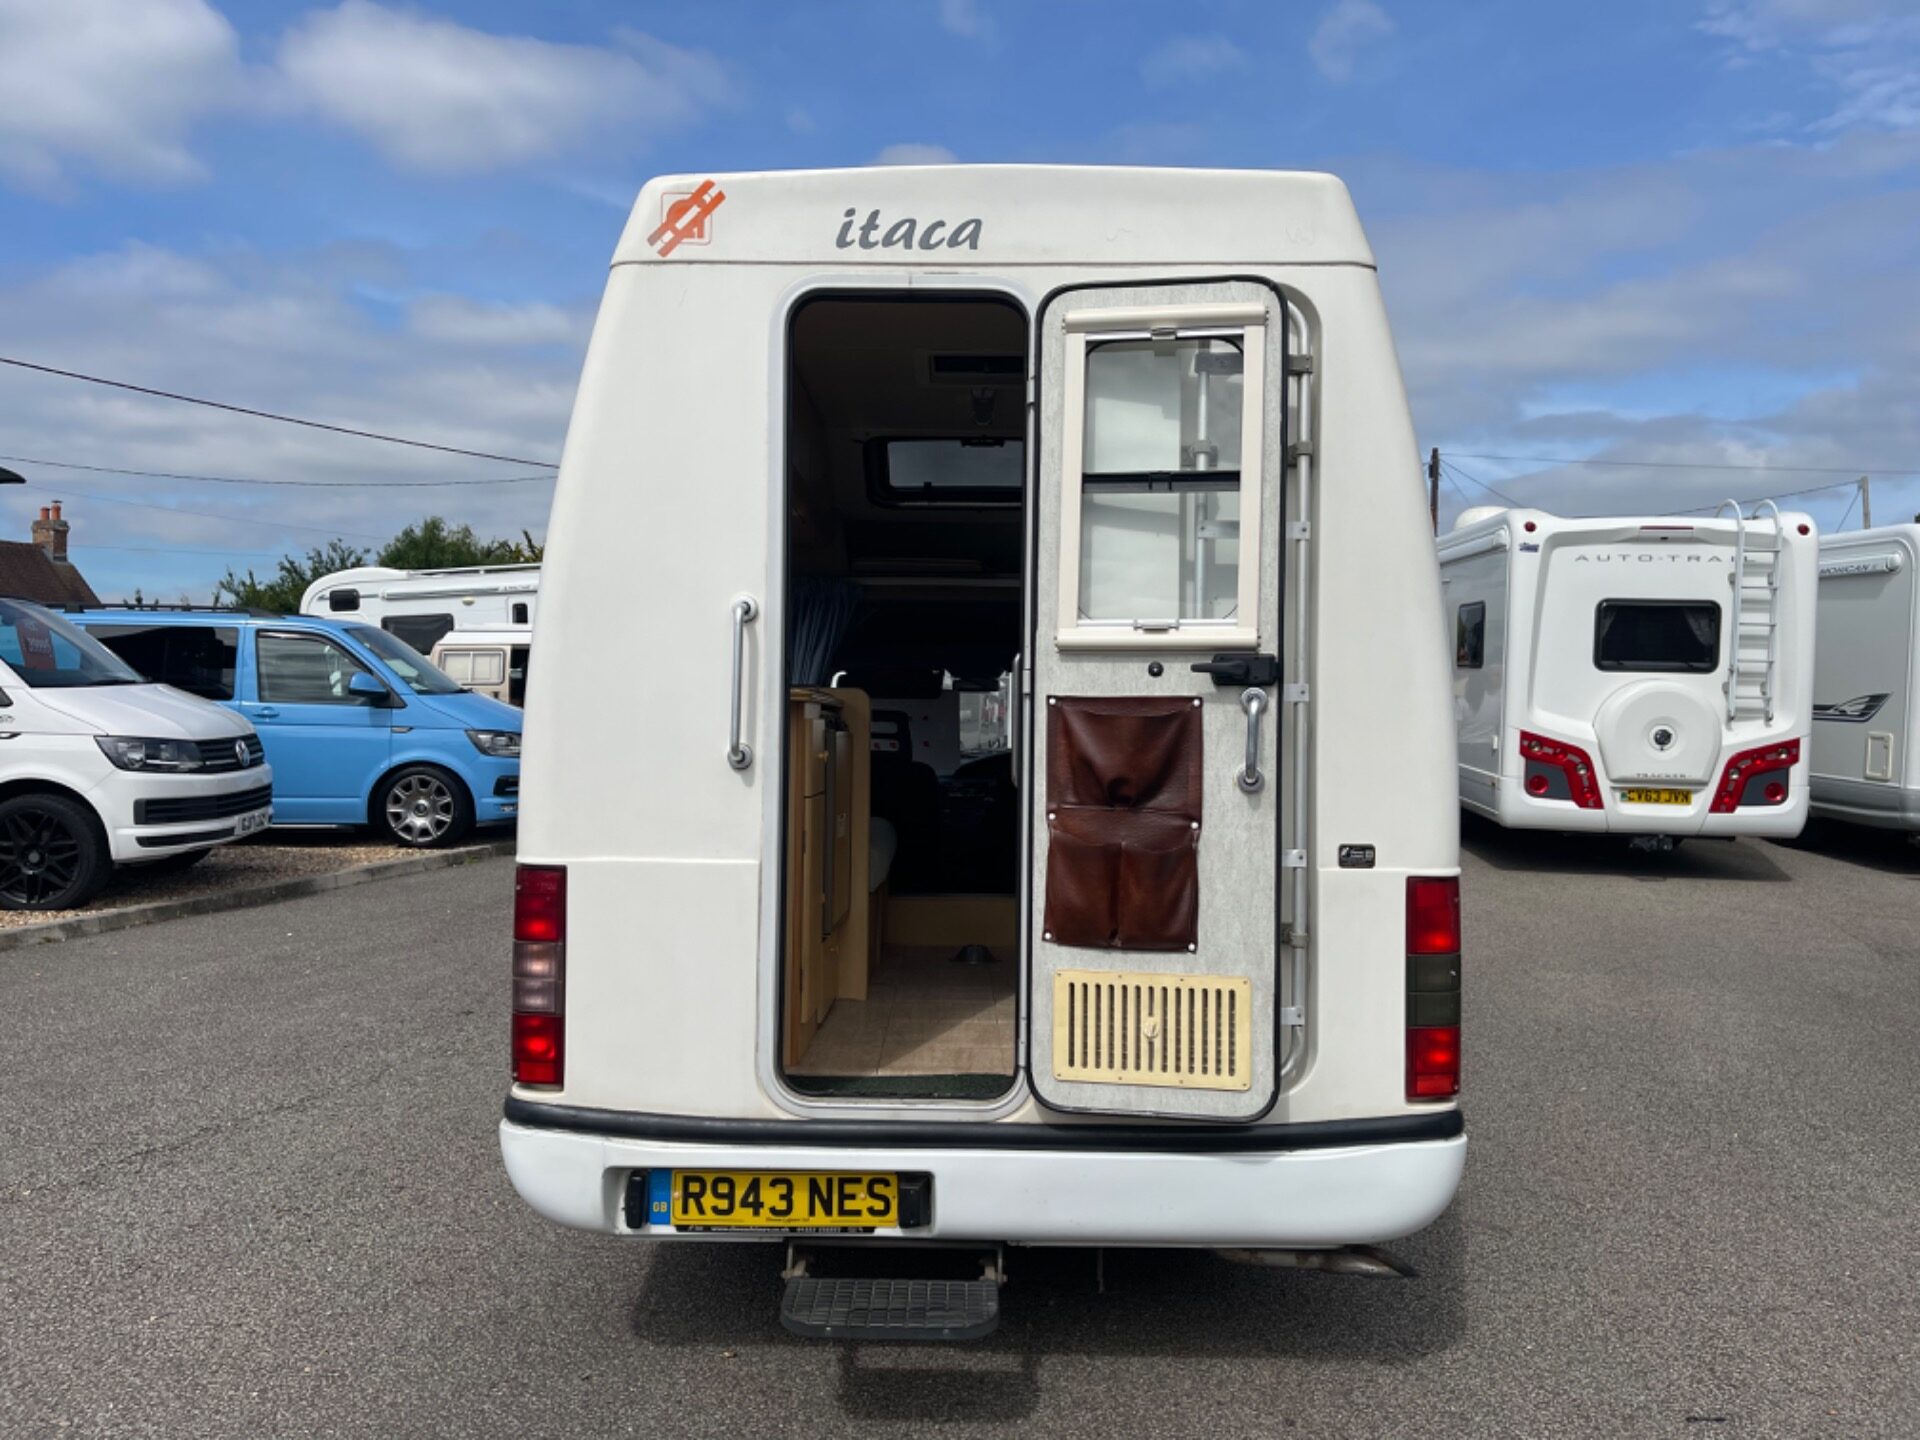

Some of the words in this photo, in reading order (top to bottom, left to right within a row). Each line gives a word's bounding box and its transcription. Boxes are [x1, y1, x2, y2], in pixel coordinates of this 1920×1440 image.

[835, 207, 983, 251] itaca
[652, 1201, 668, 1213] GB
[681, 1174, 794, 1218] R943
[808, 1176, 892, 1218] NES
